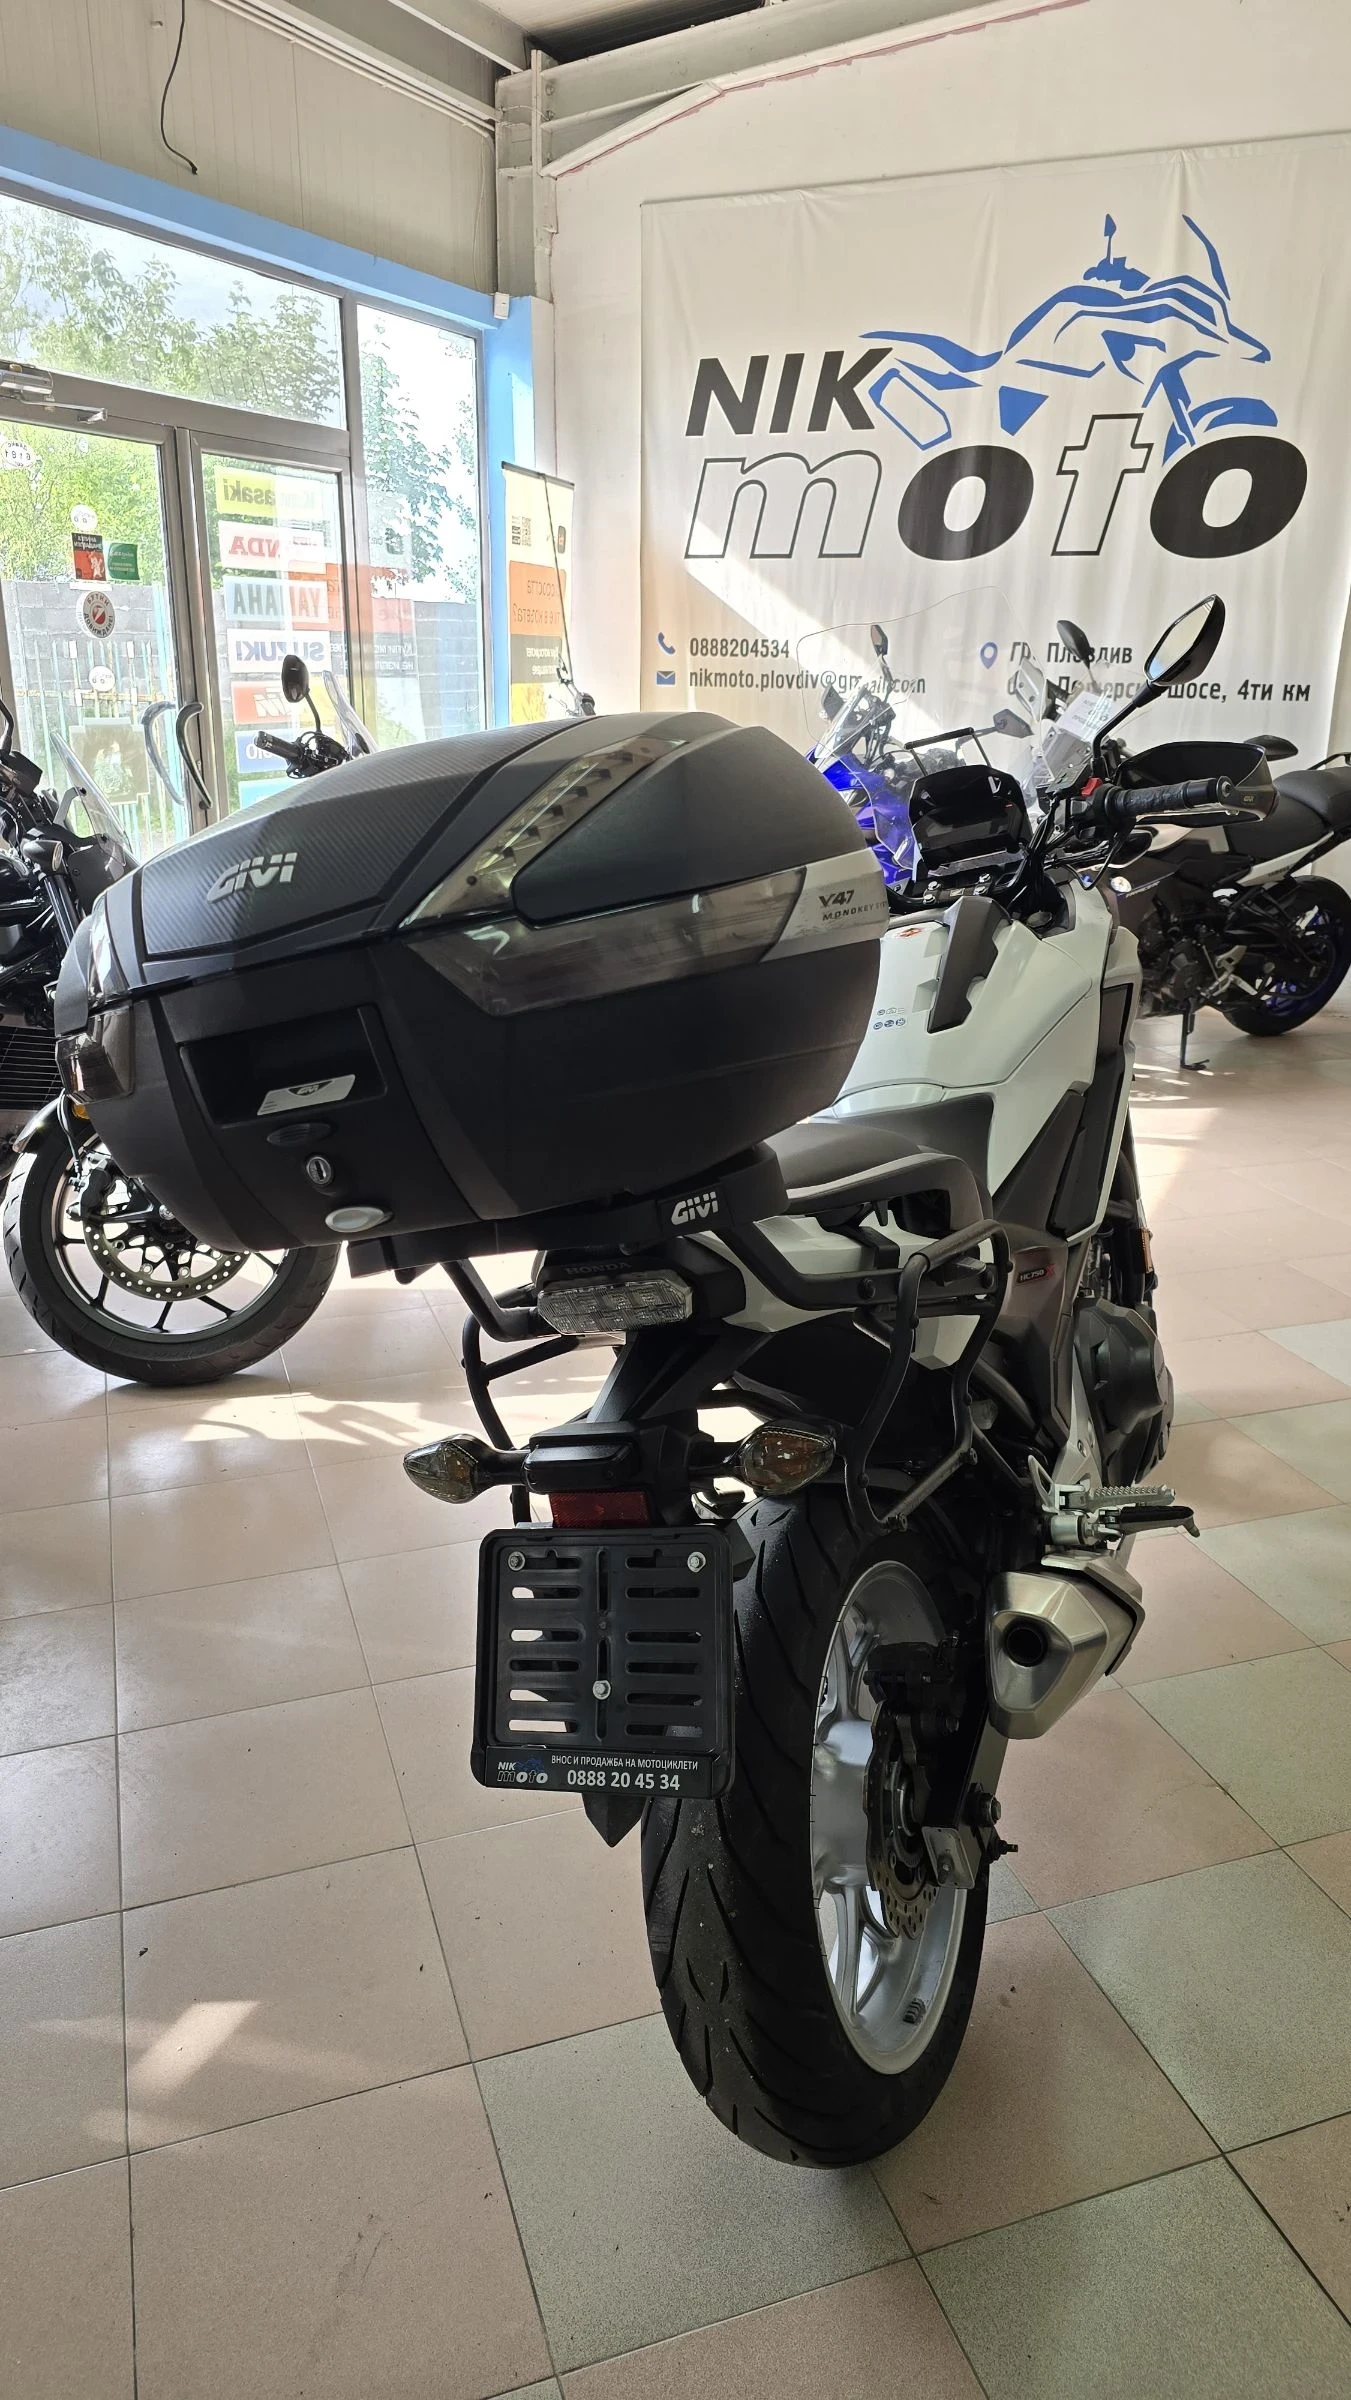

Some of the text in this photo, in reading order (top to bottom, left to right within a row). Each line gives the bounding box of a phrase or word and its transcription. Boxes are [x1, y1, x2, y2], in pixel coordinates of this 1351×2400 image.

[685, 347, 893, 437] NIK
[684, 413, 1308, 561] moto
[689, 637, 789, 658] 0888204534
[690, 667, 926, 694] nikmoto.plovdiv@gmailcom
[1237, 679, 1273, 701] 4ти
[1282, 683, 1311, 702] км
[207, 852, 297, 903] GIVI
[819, 889, 854, 908] V47
[823, 903, 874, 921] MONOKEY
[671, 1191, 719, 1226] GIVI
[498, 1761, 516, 1770] NIK
[551, 1755, 698, 1770] ВНОС И ПРОДАЖБА НА МОТОЦИКЛЕТИ
[497, 1770, 549, 1784] moto
[567, 1770, 680, 1790] 0888 20 45 34
